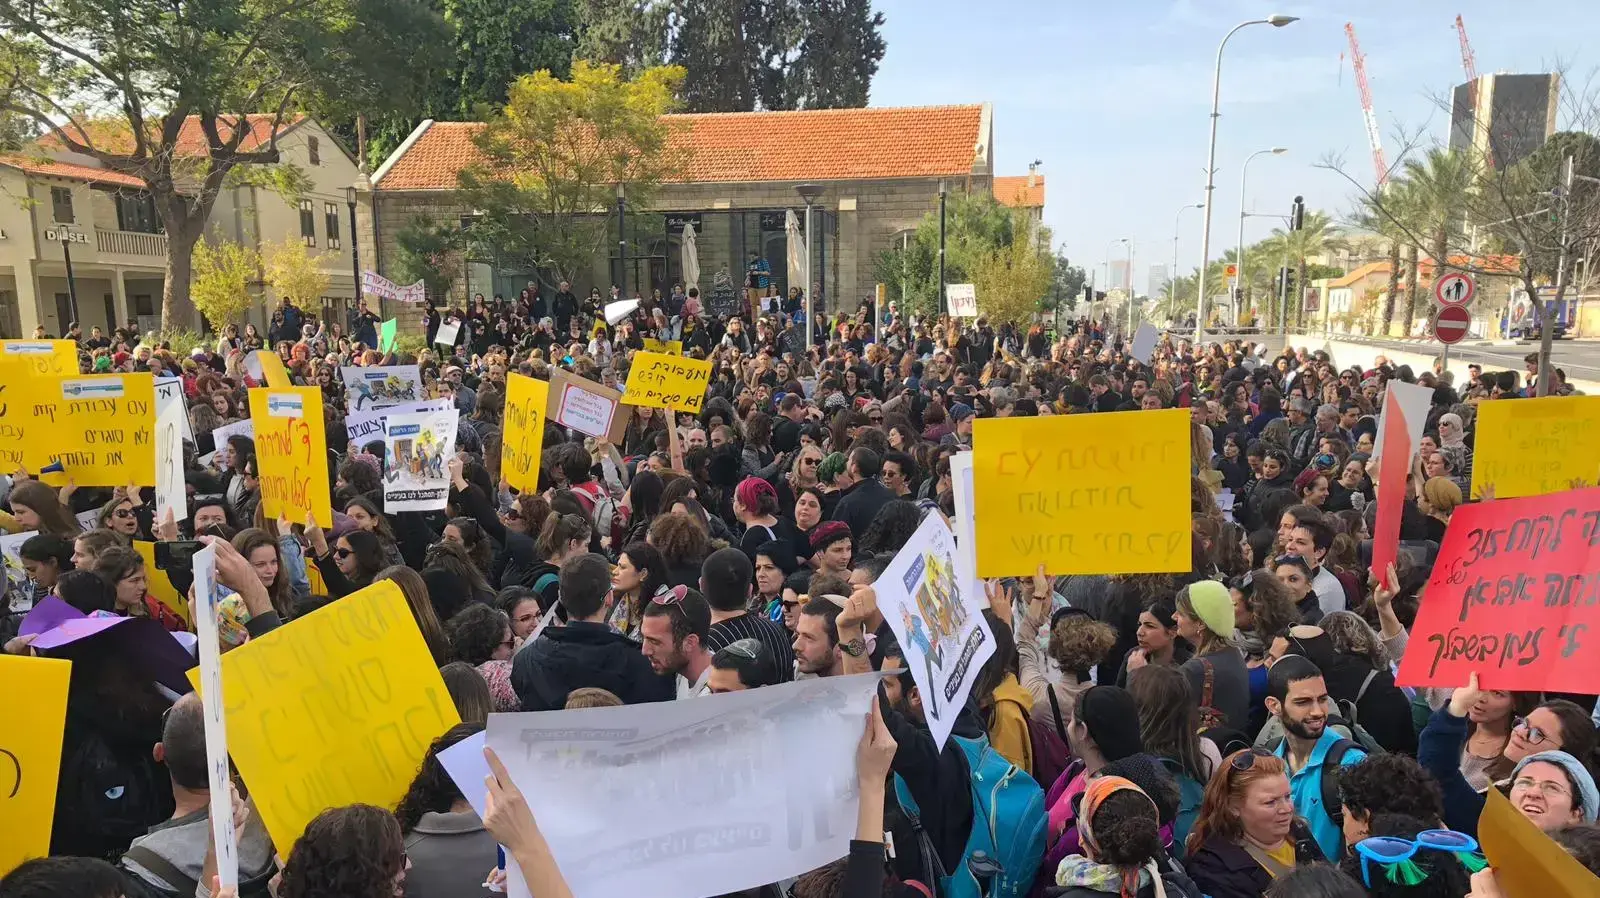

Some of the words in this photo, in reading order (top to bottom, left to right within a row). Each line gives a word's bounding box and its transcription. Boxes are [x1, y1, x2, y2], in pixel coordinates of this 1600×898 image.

[45, 230, 91, 243] DISEL
[637, 370, 666, 387] קודש
[650, 361, 707, 381] מעבודת
[645, 390, 680, 404] סוגרים
[684, 394, 702, 408] לא
[66, 398, 117, 416] עבודת
[127, 399, 148, 417] עם
[85, 429, 124, 444] סוגרים
[134, 424, 149, 446] לא
[105, 450, 124, 466] את
[1491, 571, 1538, 606] אבל
[1498, 625, 1547, 670] זמן
[1558, 623, 1589, 659] לי
